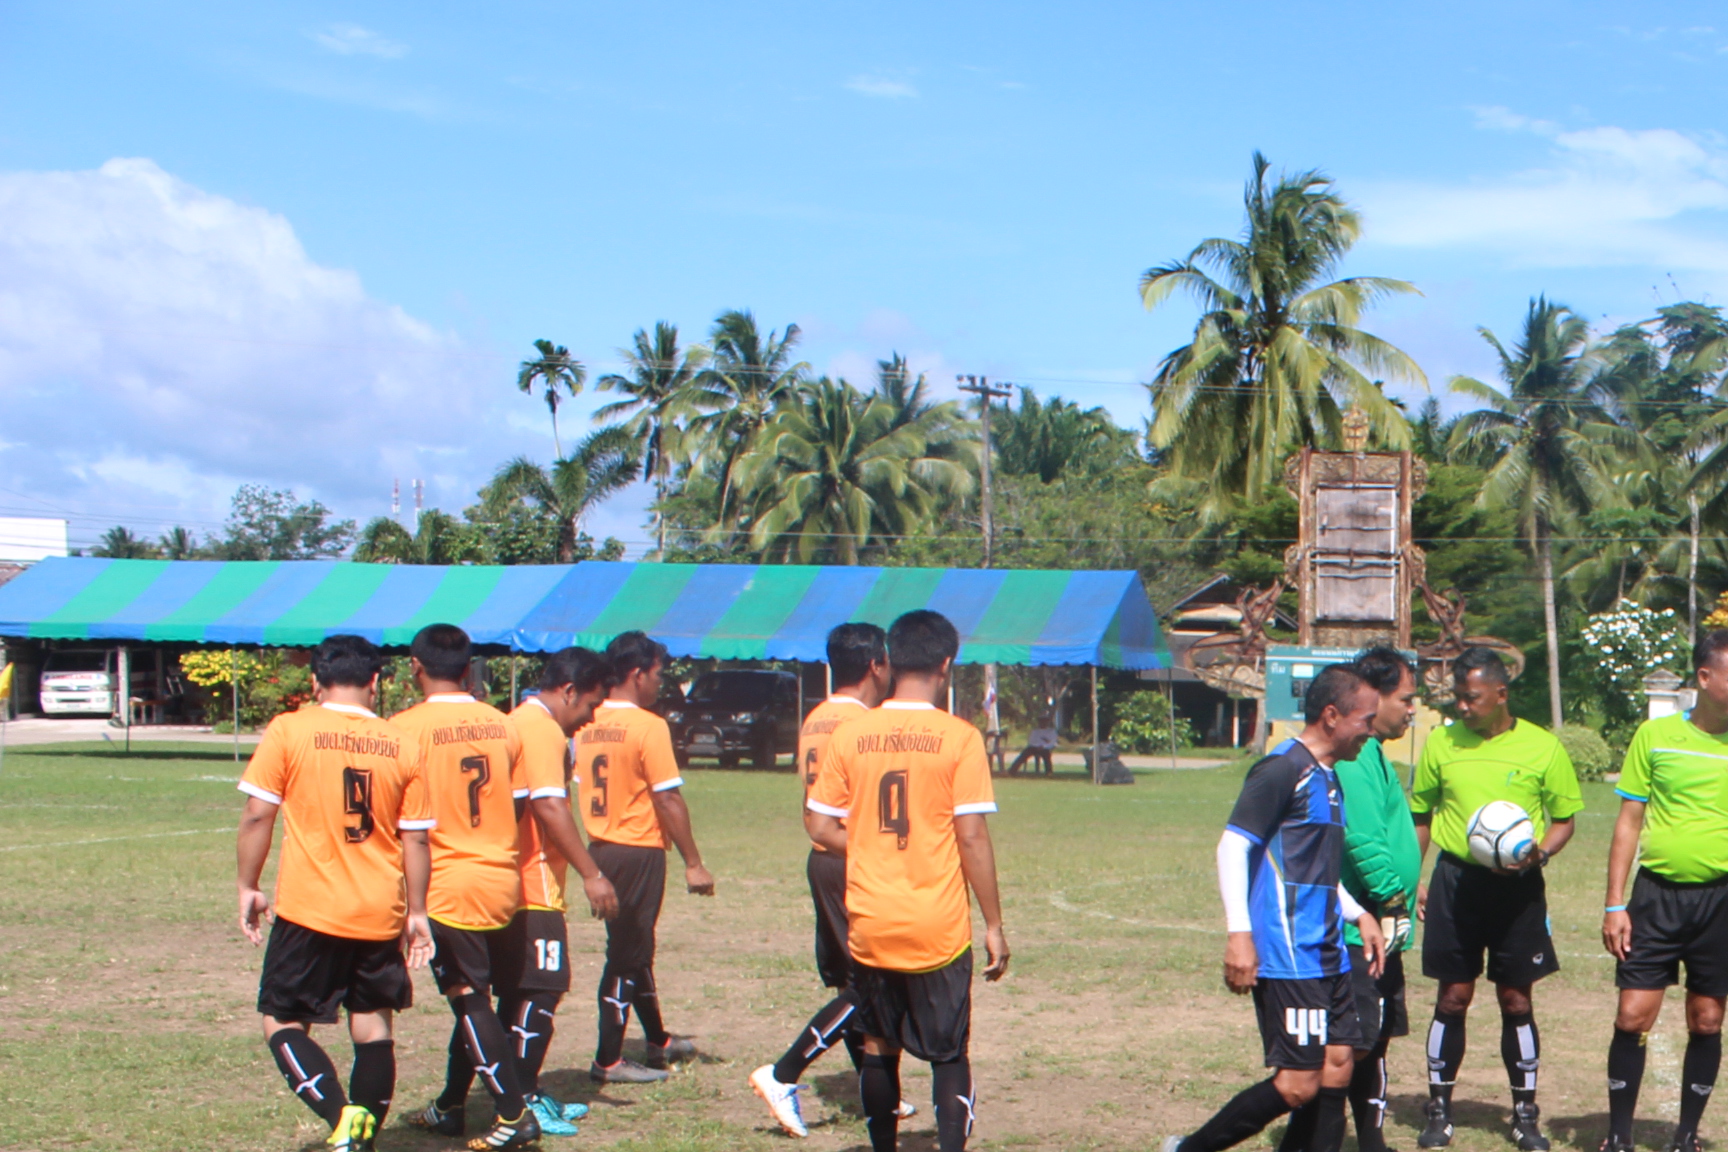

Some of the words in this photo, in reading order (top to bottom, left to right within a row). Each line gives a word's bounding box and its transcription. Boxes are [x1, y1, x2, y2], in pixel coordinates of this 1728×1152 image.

[342, 766, 374, 844] 9
[460, 755, 491, 828] 7
[591, 754, 609, 817] 5
[534, 938, 561, 972] 13
[1285, 1007, 1328, 1046] 44
